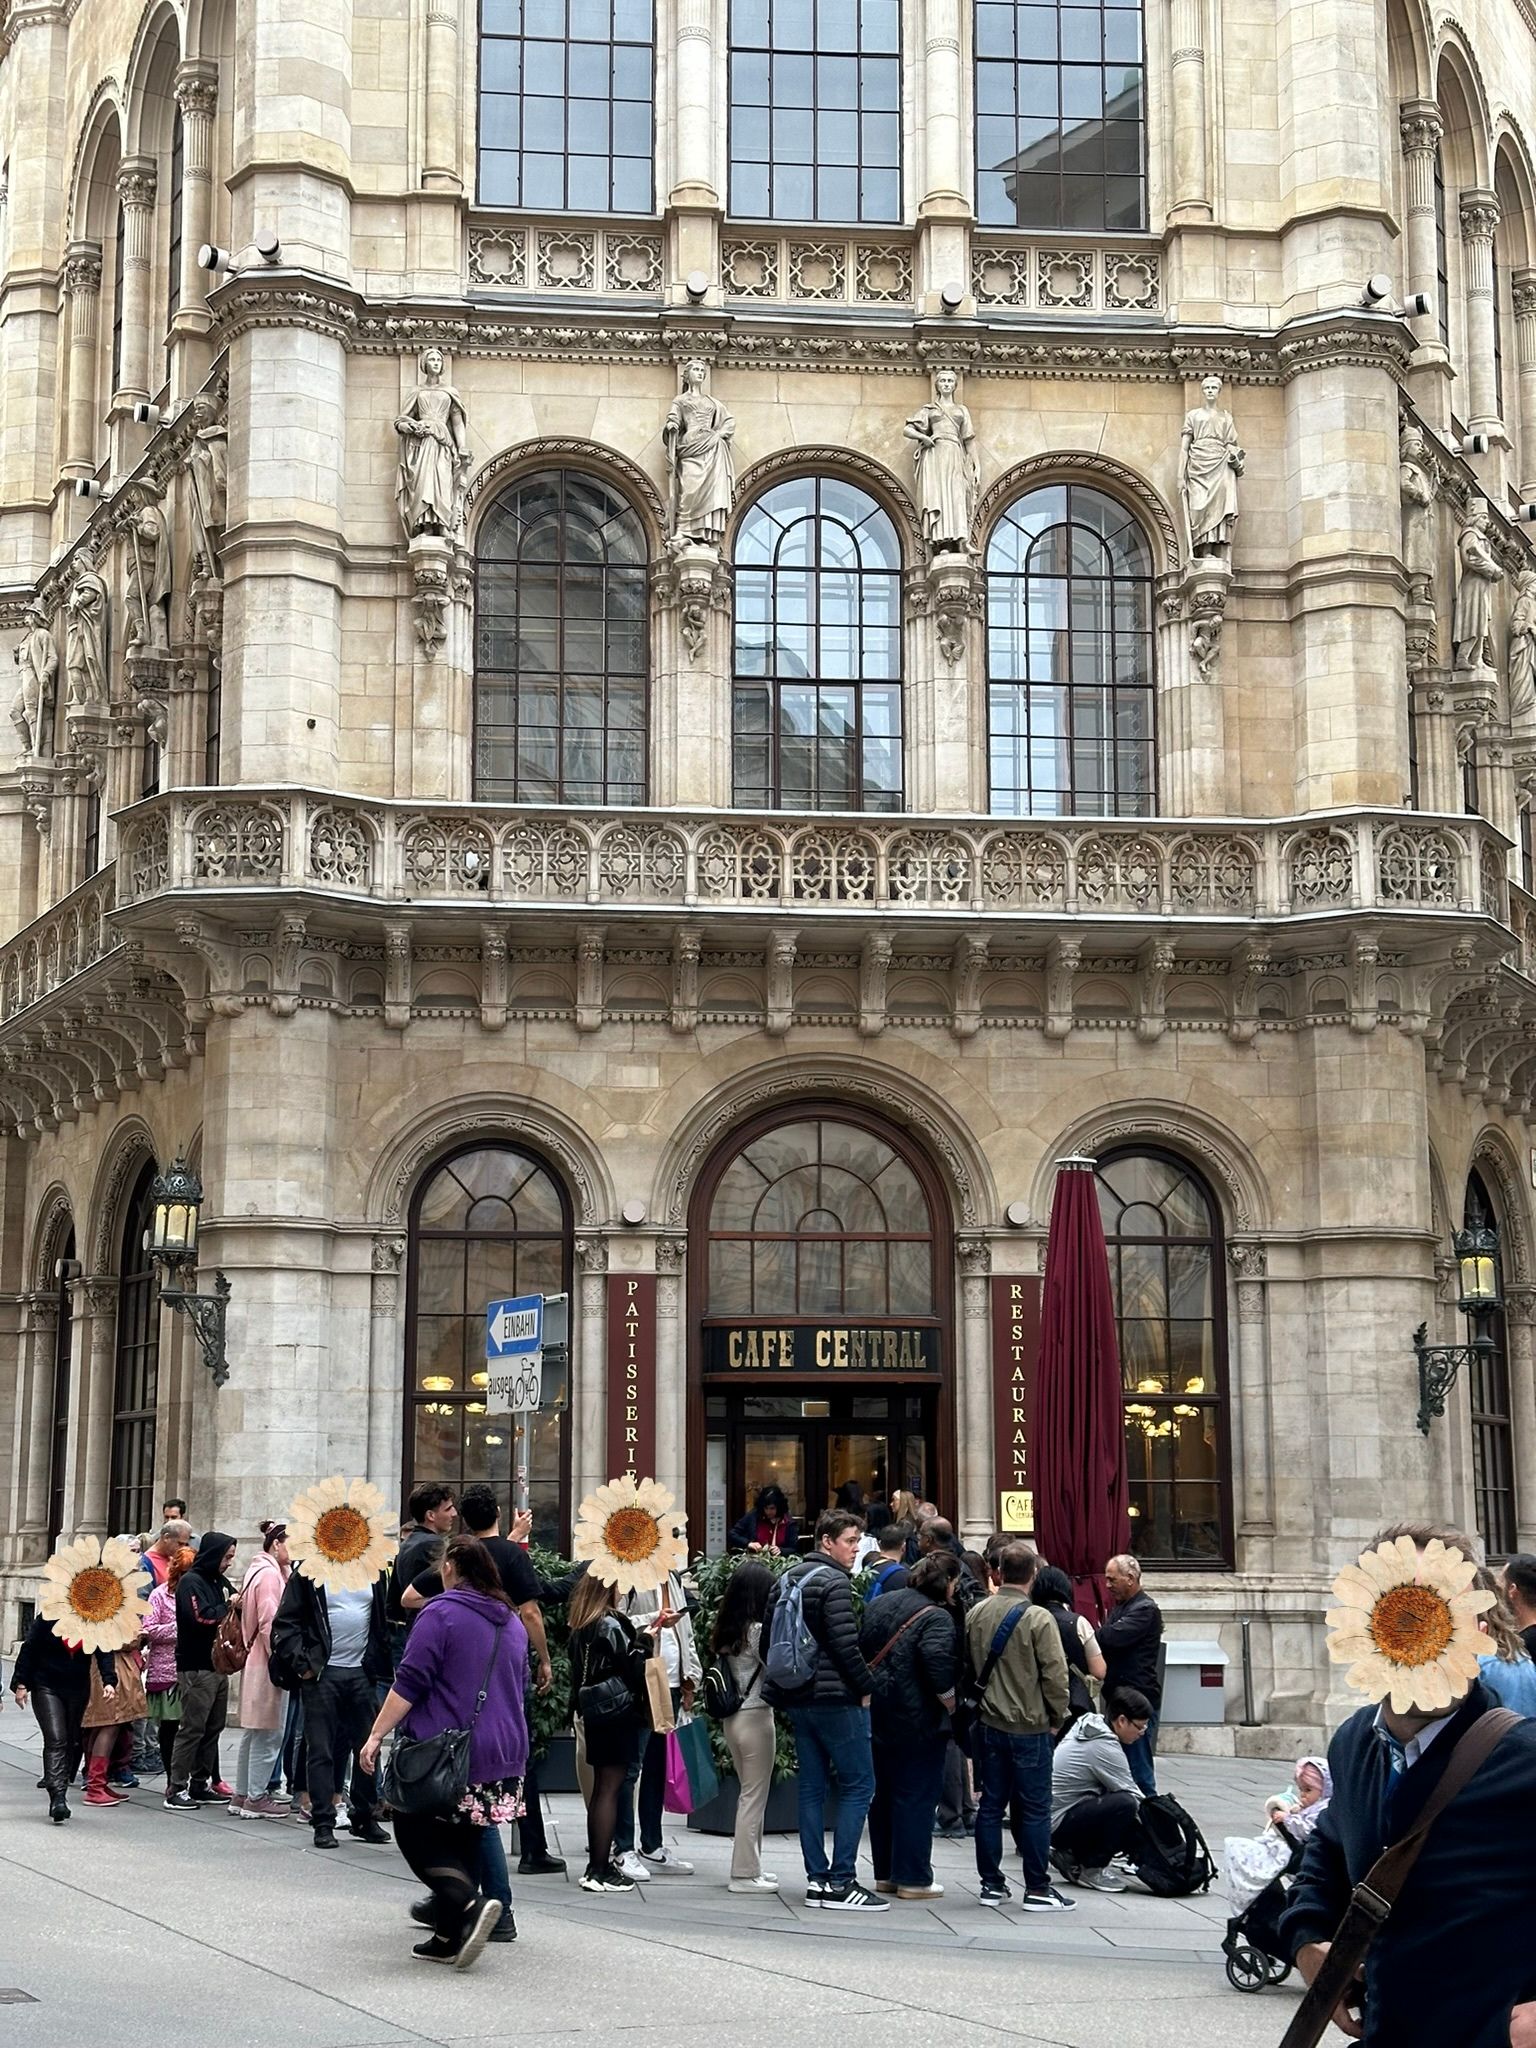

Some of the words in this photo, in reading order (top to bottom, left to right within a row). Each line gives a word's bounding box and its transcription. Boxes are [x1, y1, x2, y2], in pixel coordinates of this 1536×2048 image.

[504, 1312, 536, 1339] EINBAHN
[728, 1330, 795, 1368] CAFE
[815, 1330, 927, 1369] CENTRAL
[1010, 1284, 1027, 1486] RESTAURANT
